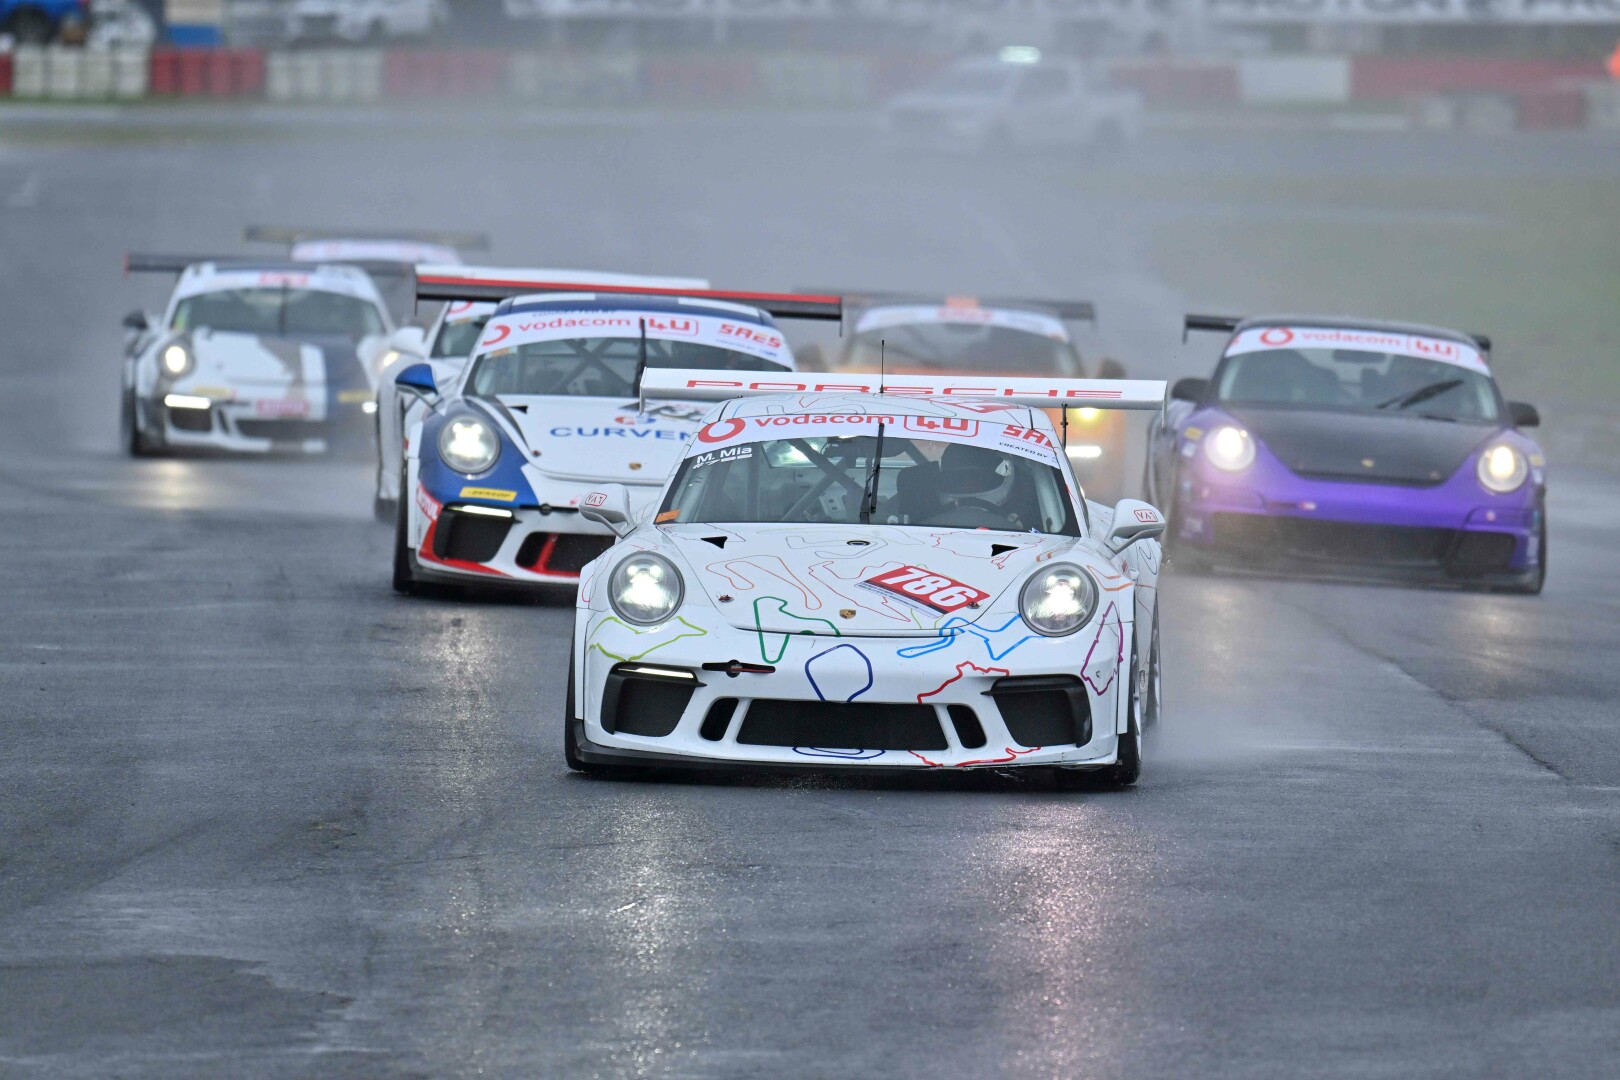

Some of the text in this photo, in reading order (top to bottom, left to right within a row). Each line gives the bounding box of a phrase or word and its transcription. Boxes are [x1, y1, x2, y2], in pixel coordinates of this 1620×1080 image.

[518, 317, 690, 331] vodacom 4U
[1301, 331, 1401, 347] vodacom
[686, 380, 1123, 398] PORSCHE
[754, 413, 895, 427] vodacom
[696, 447, 752, 464] M. Mia
[881, 567, 978, 607] 786
